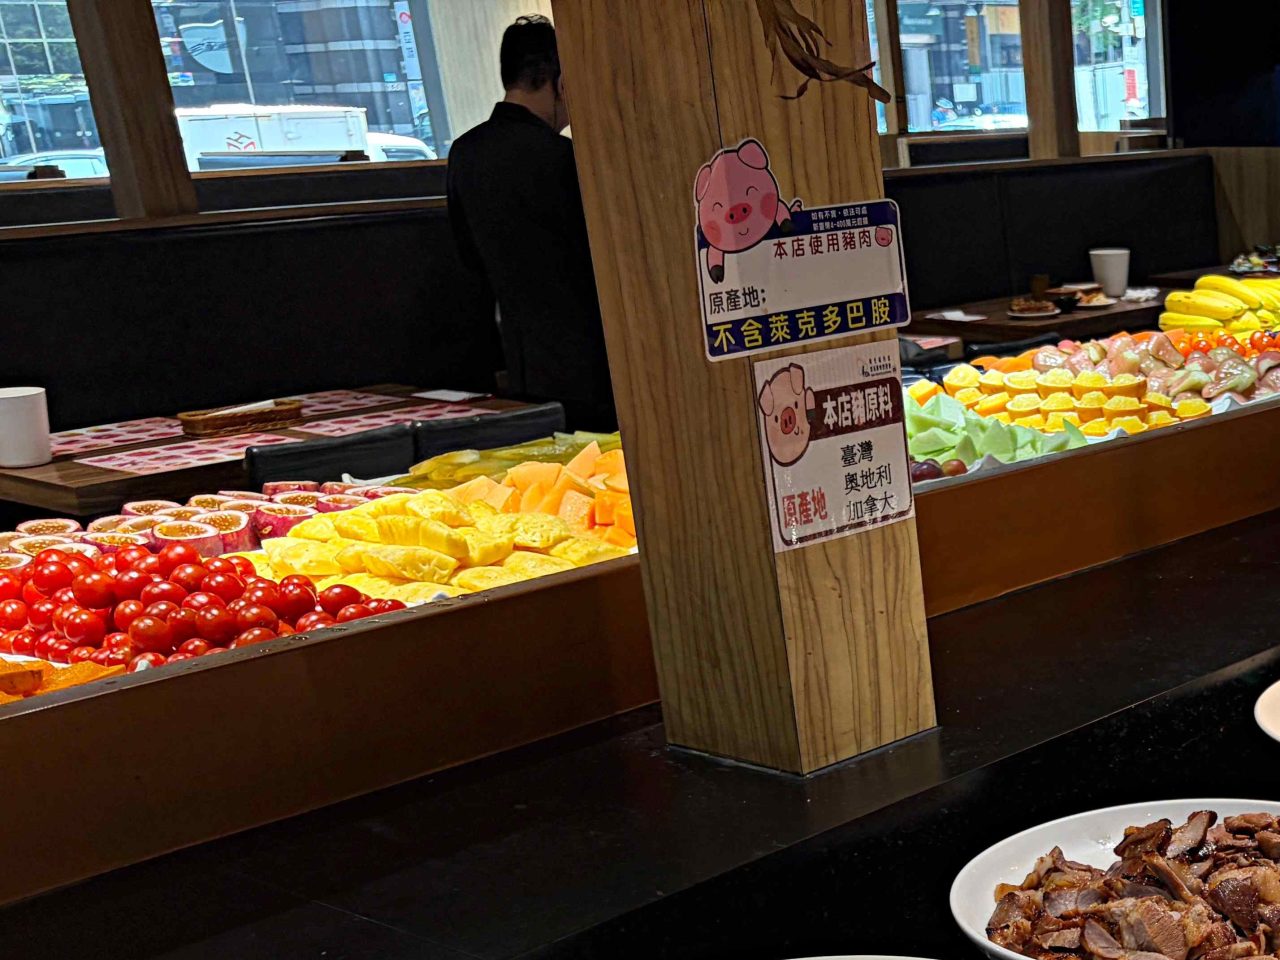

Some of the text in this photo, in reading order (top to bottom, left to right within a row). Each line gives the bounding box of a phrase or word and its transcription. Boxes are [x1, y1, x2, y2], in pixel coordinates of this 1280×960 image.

[773, 228, 872, 259] 本店使用豬肉
[712, 297, 891, 352] 不含萊克多巴胺
[822, 383, 893, 430] 本店豬原料
[840, 440, 874, 468] 臺灣
[845, 463, 892, 495] 奧地利
[782, 486, 828, 528] 原產地
[847, 491, 895, 522] 加拿大
